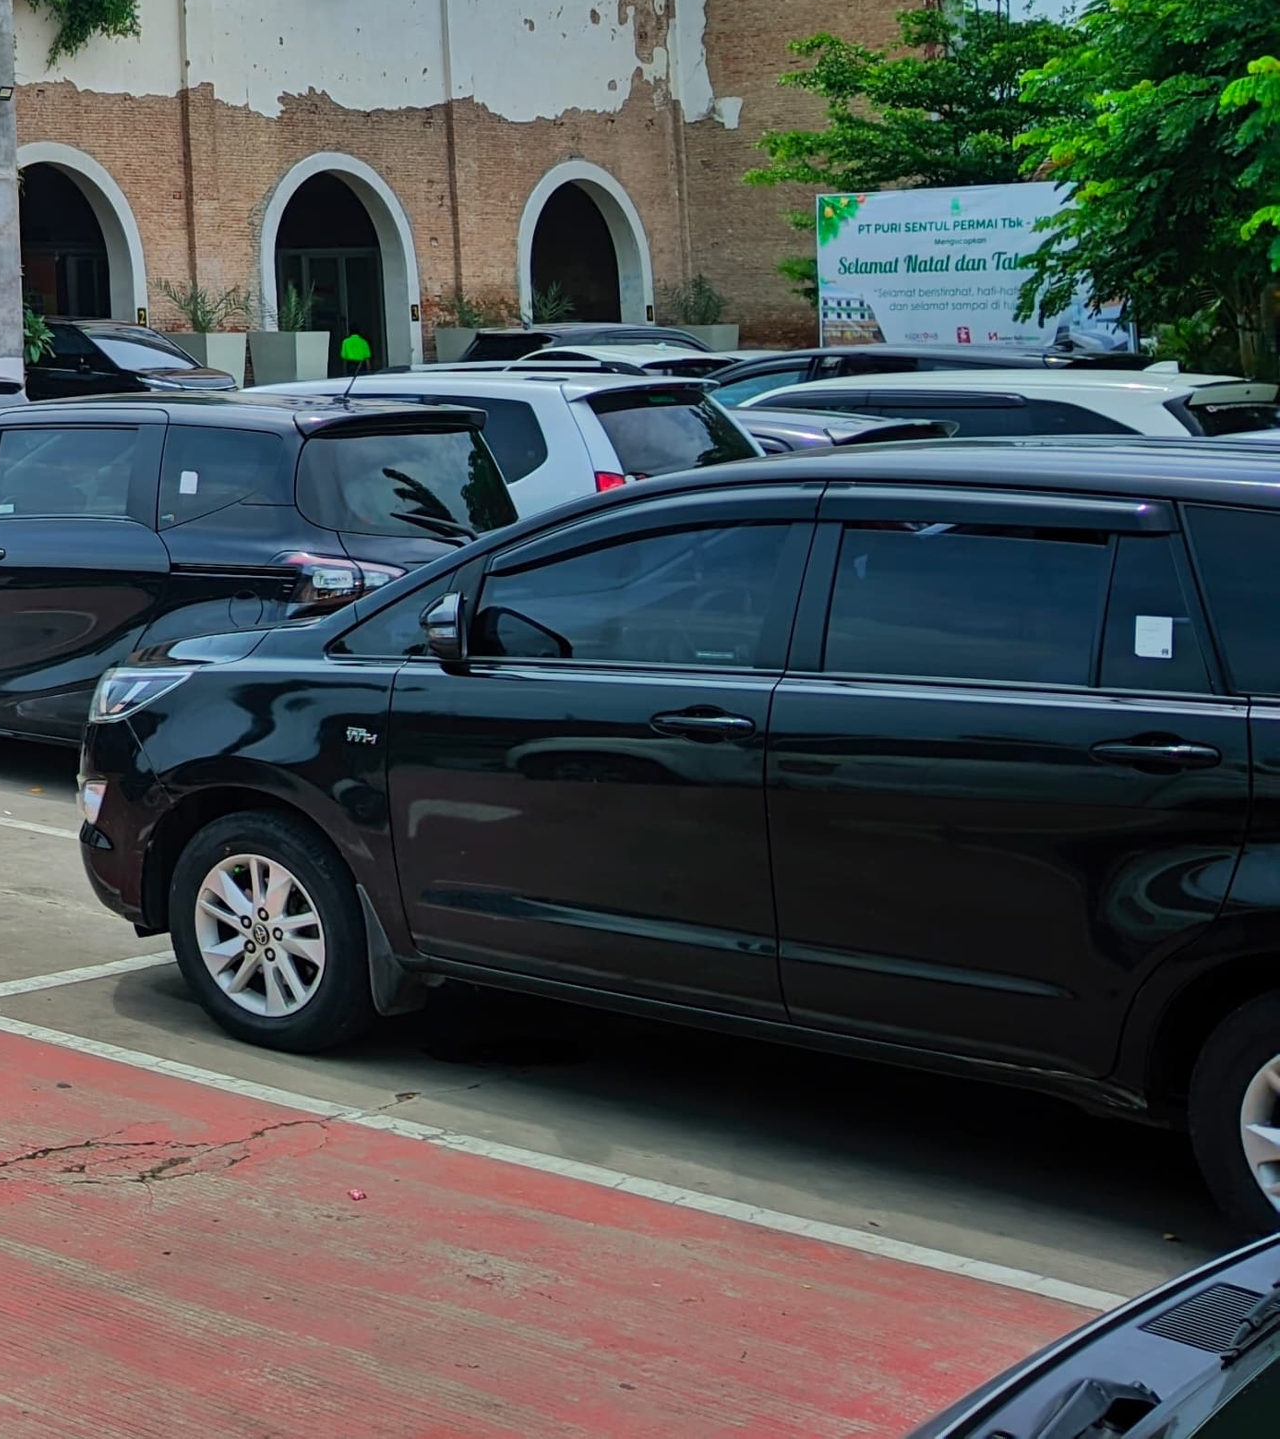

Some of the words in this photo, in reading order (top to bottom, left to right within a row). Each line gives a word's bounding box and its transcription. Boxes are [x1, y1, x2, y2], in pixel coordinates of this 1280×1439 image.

[858, 223, 872, 234] PT
[874, 222, 901, 234] PURI
[904, 221, 950, 233] SENTUL
[953, 217, 998, 231] PERMAI
[1001, 217, 1023, 229] Tbk
[838, 256, 899, 275] Selamat
[903, 254, 951, 274] Natal
[955, 254, 987, 272] dan
[139, 310, 146, 324] 2
